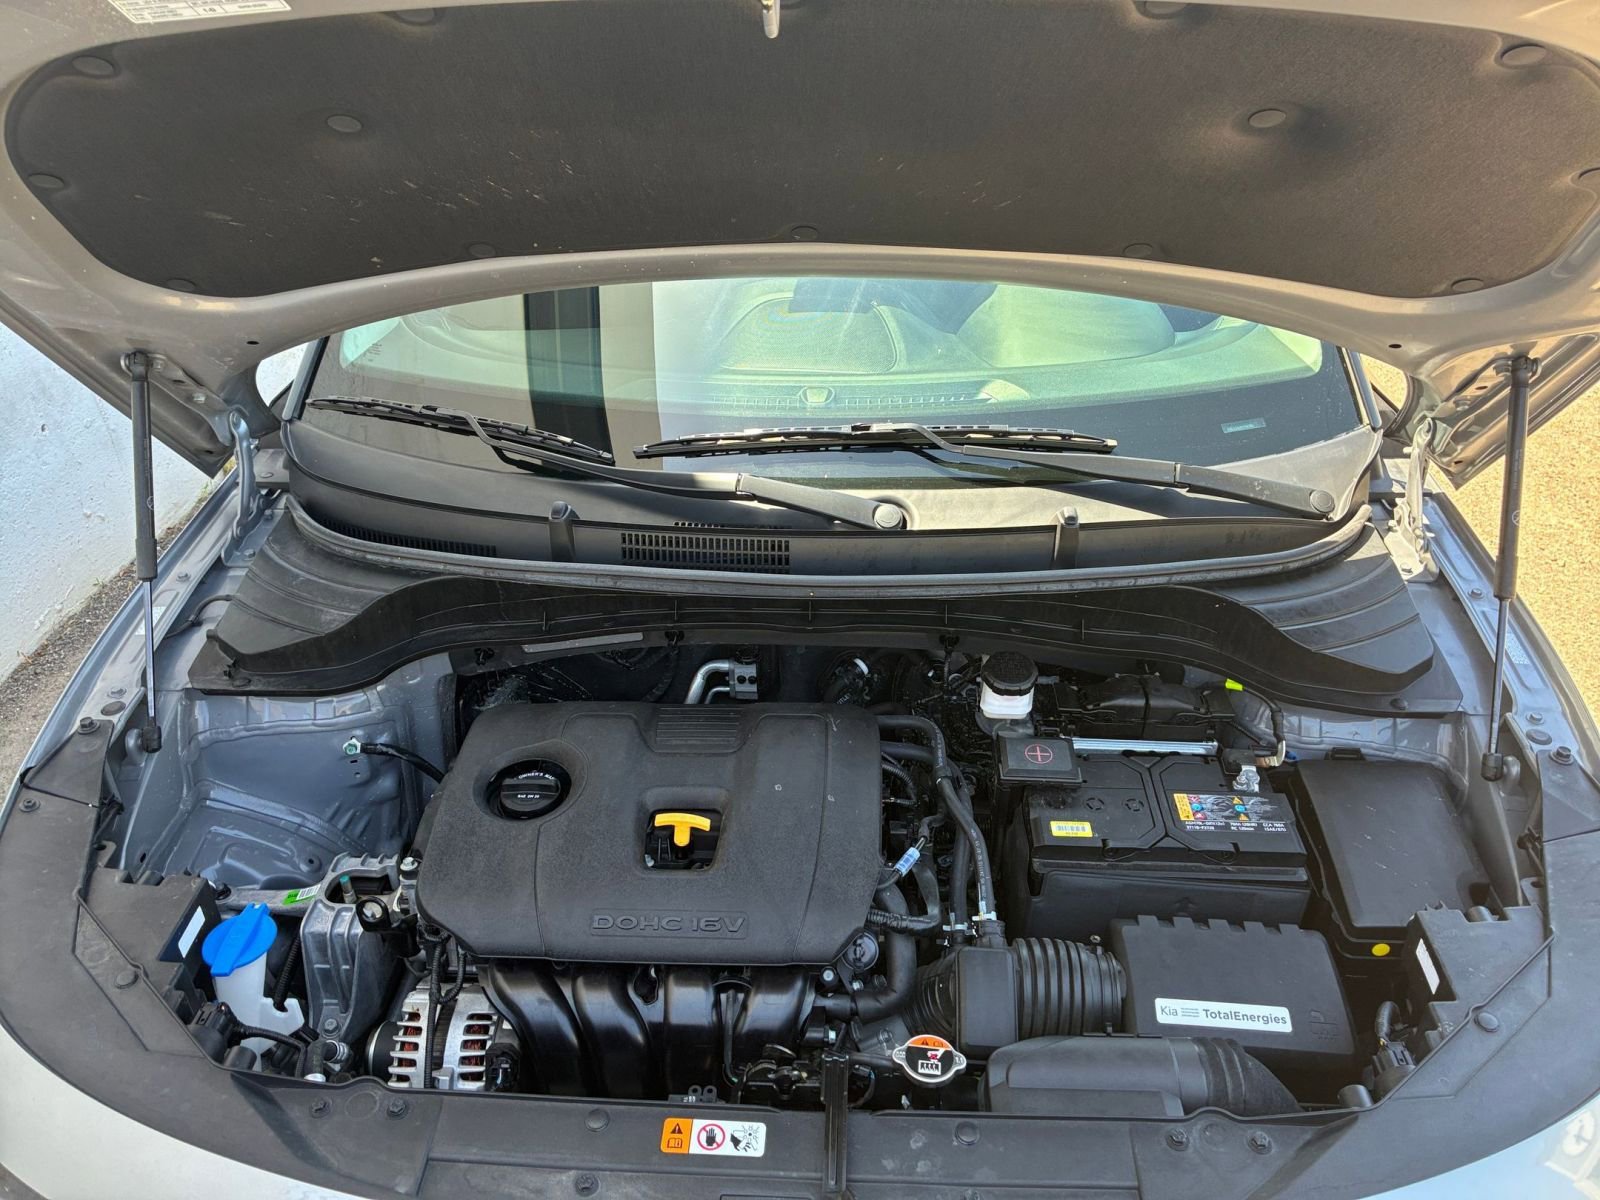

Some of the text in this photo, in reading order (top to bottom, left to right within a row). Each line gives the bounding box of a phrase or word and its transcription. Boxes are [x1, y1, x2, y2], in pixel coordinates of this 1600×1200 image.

[592, 914, 746, 933] DOHC 16V
[1160, 1005, 1288, 1025] Kia TotalEnergies
